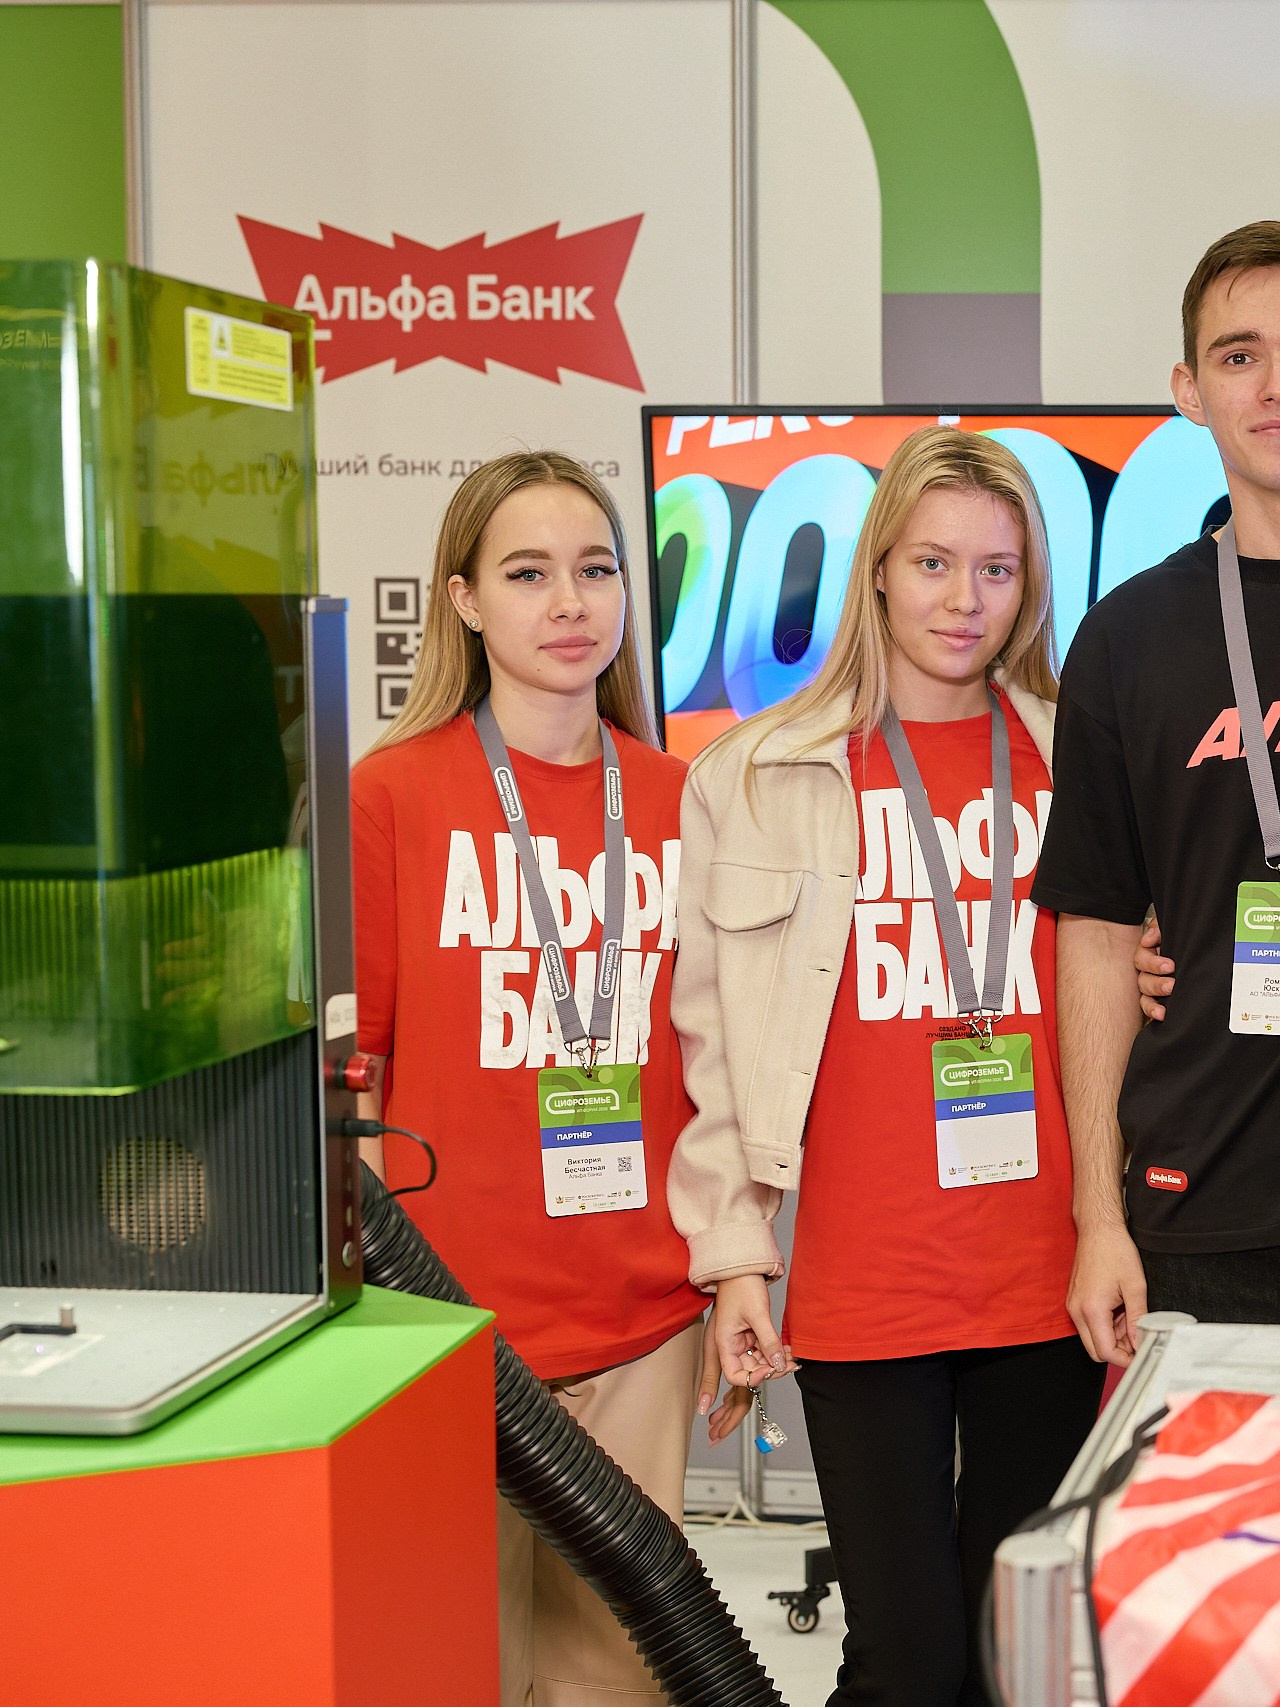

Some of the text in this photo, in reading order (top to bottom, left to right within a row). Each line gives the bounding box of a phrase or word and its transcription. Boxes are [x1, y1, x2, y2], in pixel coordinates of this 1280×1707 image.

[293, 273, 596, 333] Альфа Банк
[378, 453, 441, 477] банк
[856, 788, 1053, 900] ЛЬФ
[854, 899, 1041, 1021] БАНК
[480, 951, 663, 1069] БАНК
[949, 1067, 1004, 1079] ЦИФРОЗЕМЬЕ
[554, 1096, 611, 1107] ЦИФРОЗЕМЬЕ
[951, 1101, 987, 1112] ПАРТНЁР
[557, 1131, 592, 1140] ПАРТНЁР
[1150, 1172, 1182, 1184] Альфа Банк
